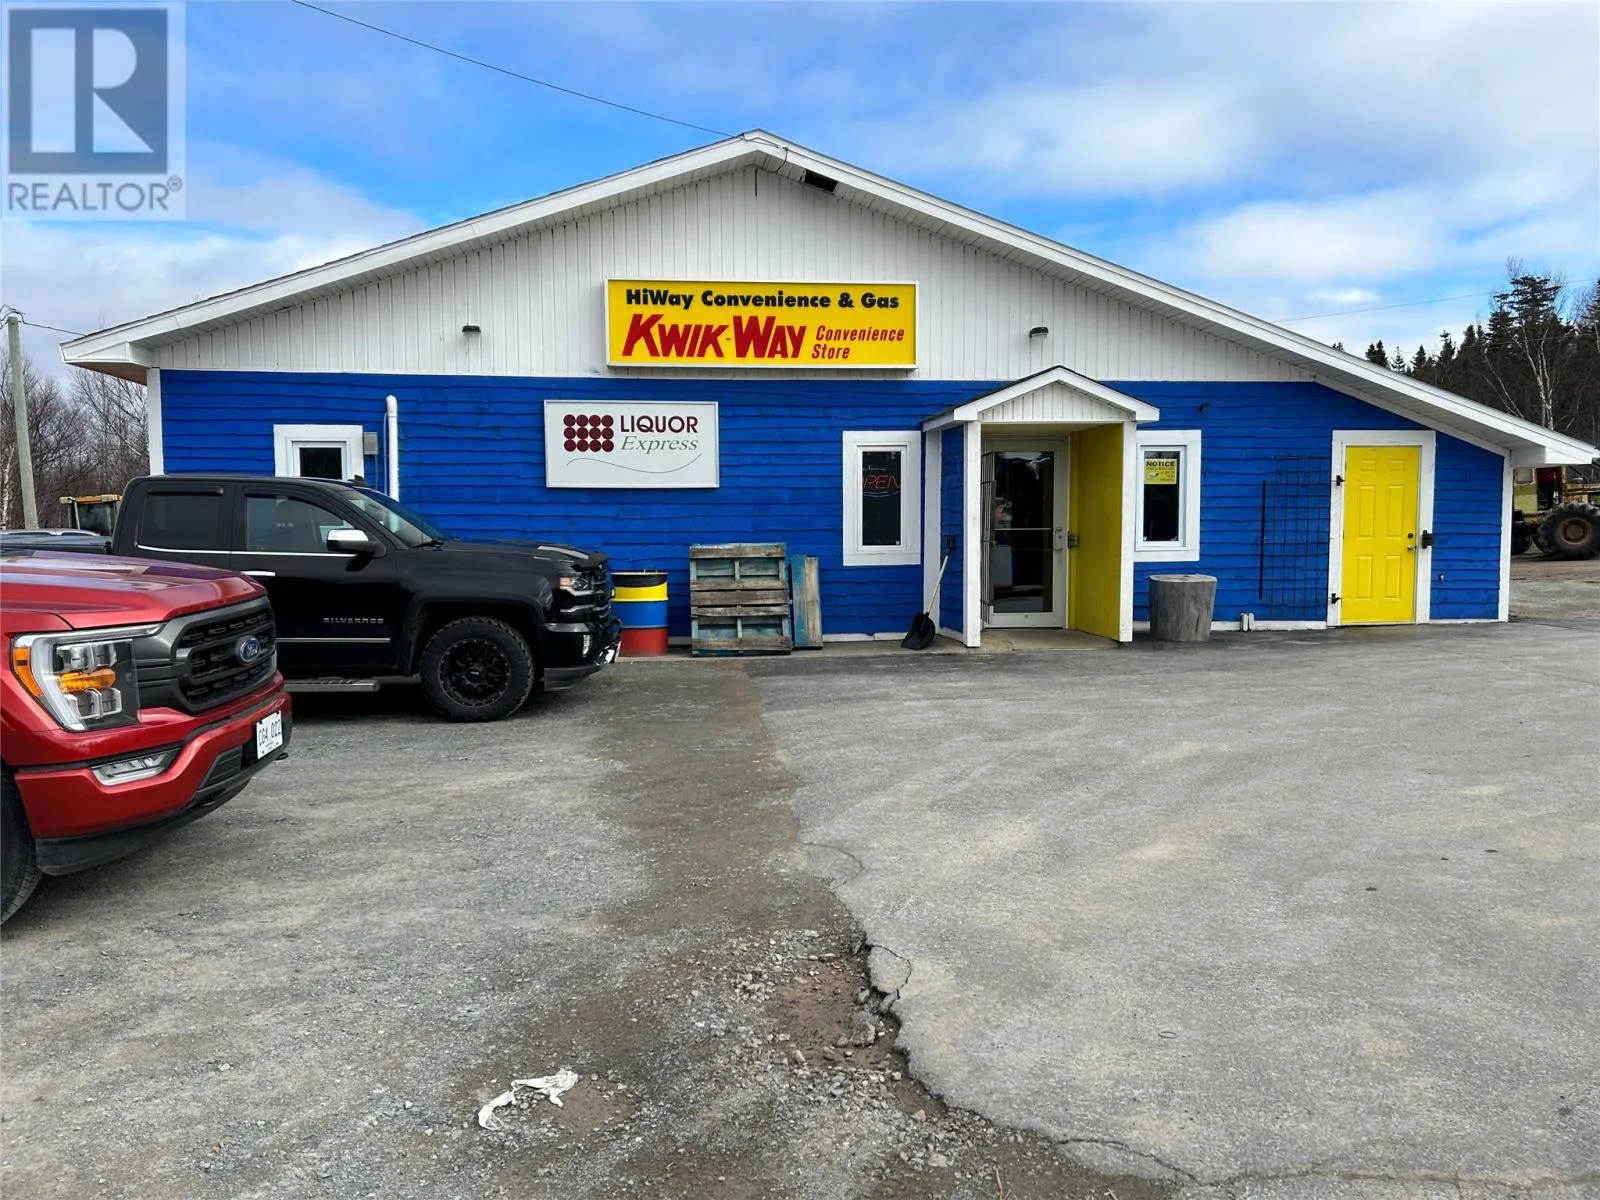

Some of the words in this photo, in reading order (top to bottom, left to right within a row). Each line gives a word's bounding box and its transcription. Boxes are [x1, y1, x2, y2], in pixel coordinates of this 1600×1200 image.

[626, 289, 694, 310] HiWay
[701, 291, 831, 308] Convenience
[838, 292, 855, 308] &
[861, 292, 899, 309] Gas
[816, 325, 904, 342] Convenience
[811, 344, 850, 360] Store
[620, 415, 698, 433] LIQUOR
[621, 435, 699, 454] Express
